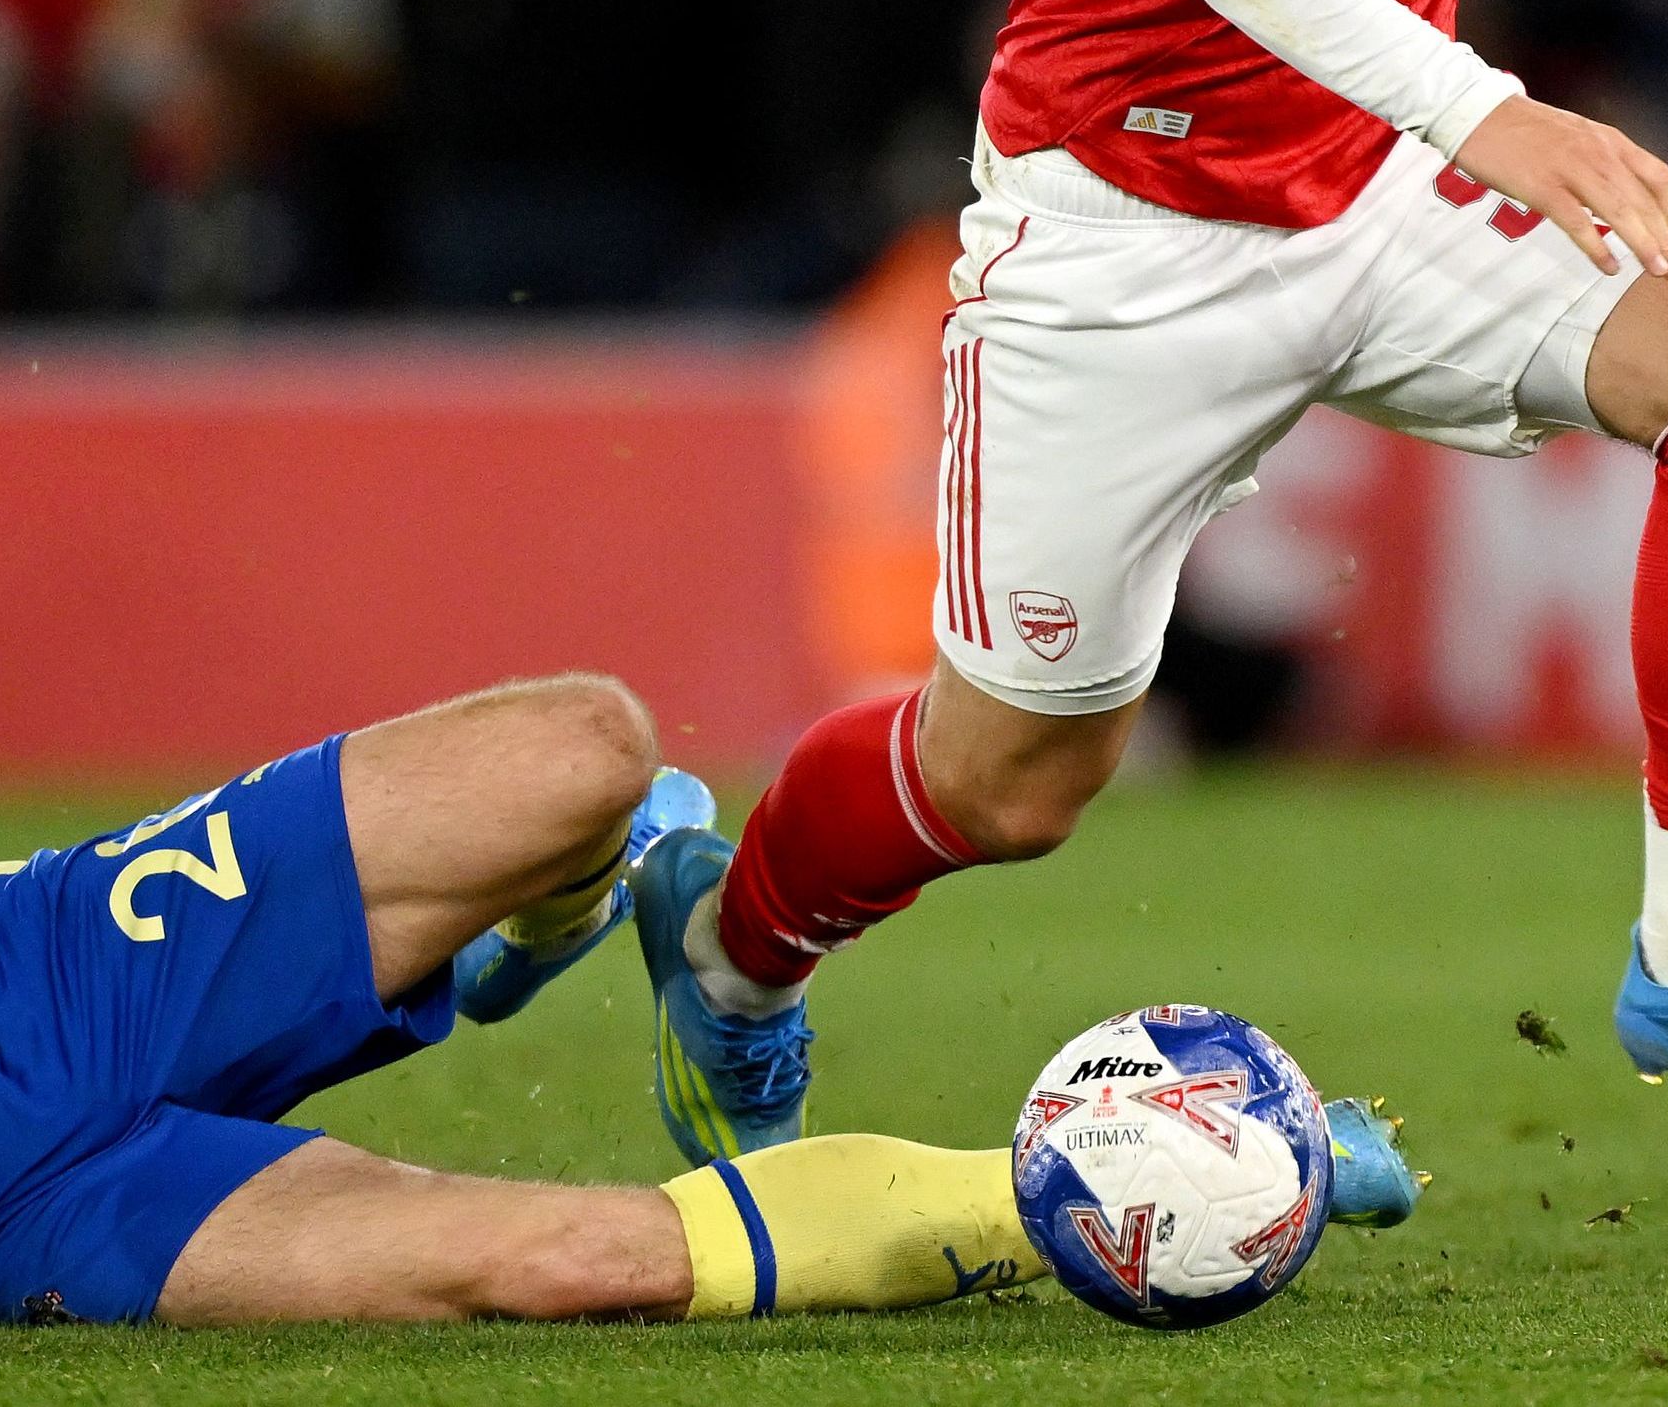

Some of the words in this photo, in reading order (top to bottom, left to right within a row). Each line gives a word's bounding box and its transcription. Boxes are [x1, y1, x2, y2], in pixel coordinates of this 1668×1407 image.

[1018, 602, 1066, 617] Arsenal
[1065, 1056, 1163, 1086] Mitre
[1066, 1128, 1145, 1151] ULTIMAX
